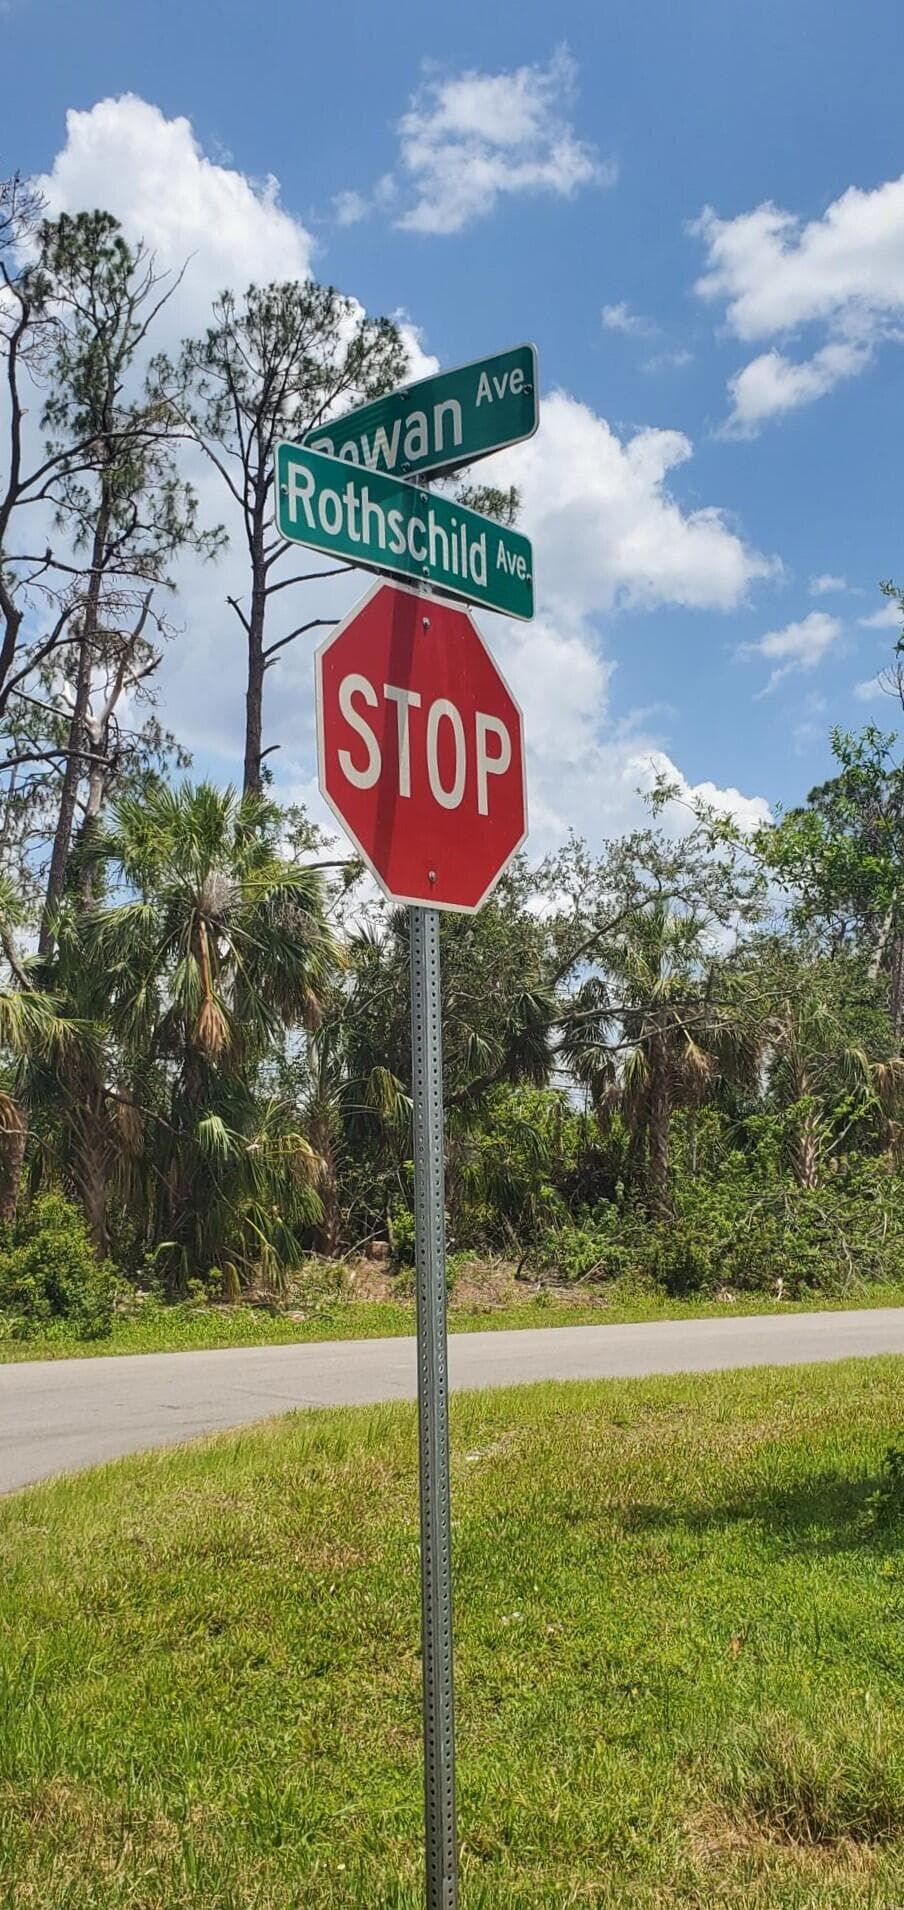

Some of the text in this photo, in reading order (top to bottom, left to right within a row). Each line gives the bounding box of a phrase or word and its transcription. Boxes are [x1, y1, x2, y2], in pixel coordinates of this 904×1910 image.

[310, 398, 462, 471] wan
[287, 461, 488, 587] Rothschild
[337, 673, 512, 816] STOP
